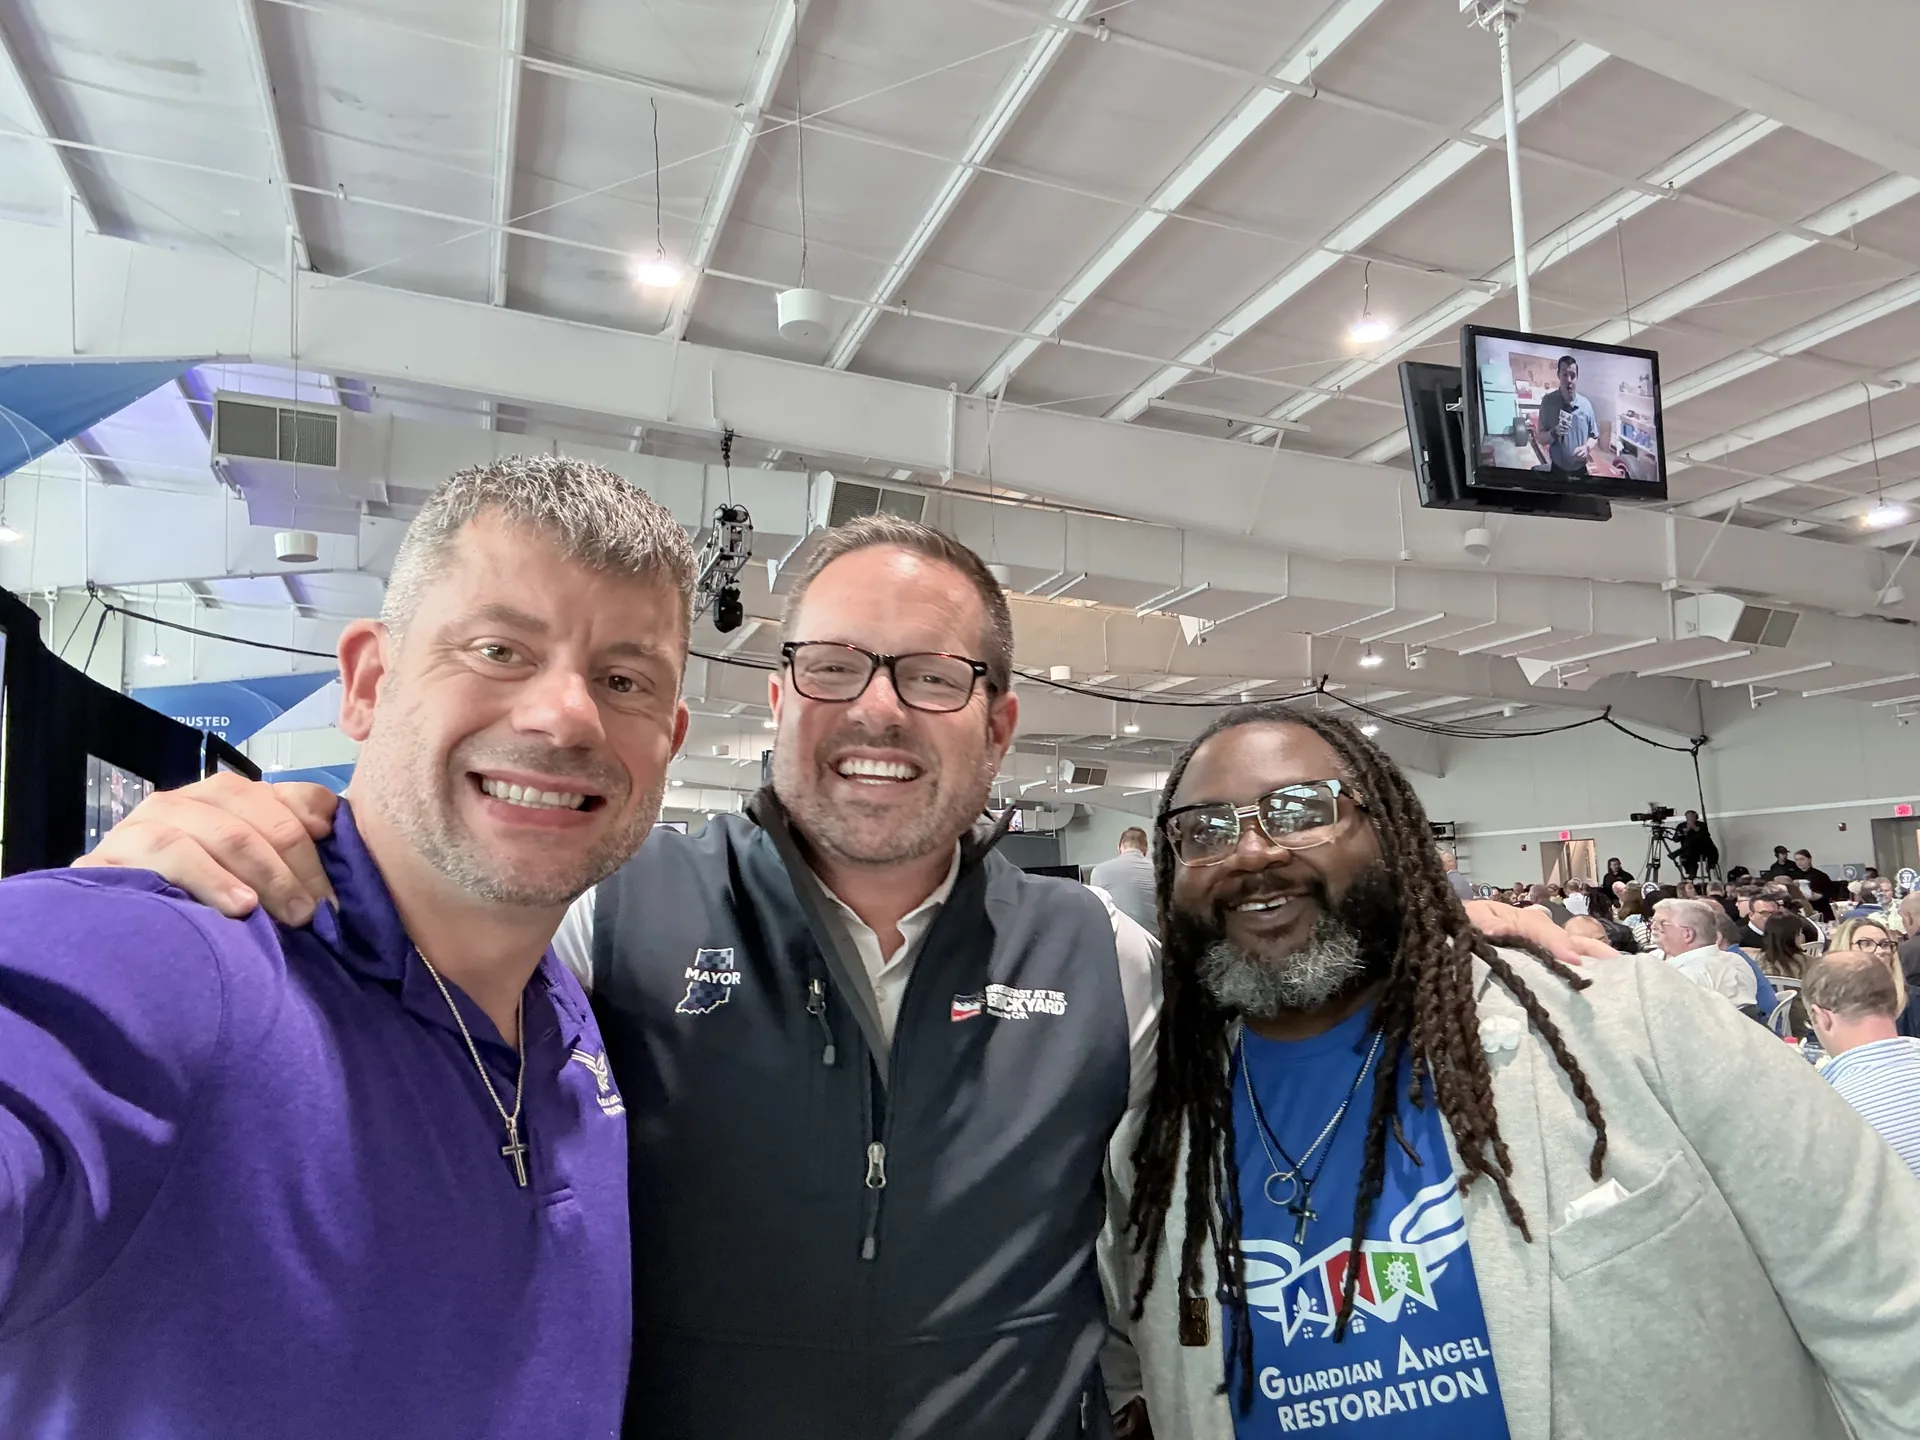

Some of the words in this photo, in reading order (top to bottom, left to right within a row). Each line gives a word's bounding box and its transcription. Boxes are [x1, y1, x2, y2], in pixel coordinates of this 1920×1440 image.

[685, 967, 741, 985] MAYOR
[986, 993, 1066, 1016] BCKYARD
[1033, 989, 1047, 999] AT
[1047, 990, 1066, 1001] THE
[1259, 1359, 1383, 1400] GUARDIAN
[1397, 1334, 1490, 1374] ANGEL
[1277, 1367, 1489, 1432] RESTORATION
